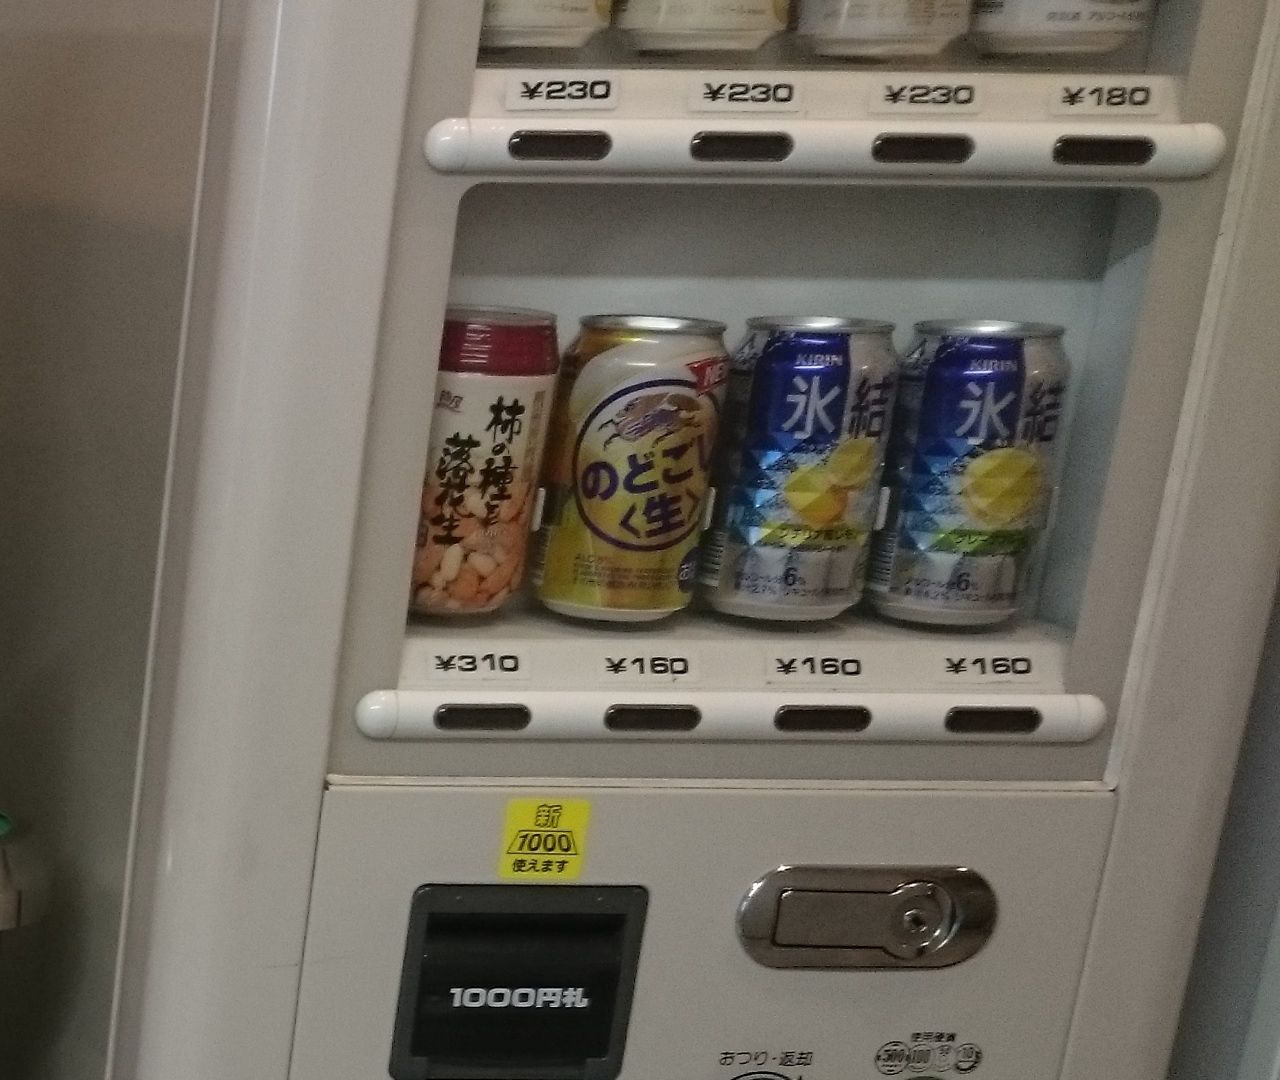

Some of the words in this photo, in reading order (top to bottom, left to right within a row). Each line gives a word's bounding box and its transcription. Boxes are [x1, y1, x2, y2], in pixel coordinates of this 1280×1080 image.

[520, 80, 611, 101] ¥230
[703, 82, 794, 103] ¥230
[885, 84, 975, 105] ¥230
[1062, 86, 1150, 106] ¥180
[435, 654, 520, 673] ¥310
[604, 656, 689, 675] ¥160
[776, 657, 862, 675] ¥160
[945, 656, 1032, 675] ¥160
[535, 804, 562, 829] 新
[517, 833, 572, 853] 1000
[512, 859, 569, 874] 使えます
[449, 987, 589, 1008] 1000円札
